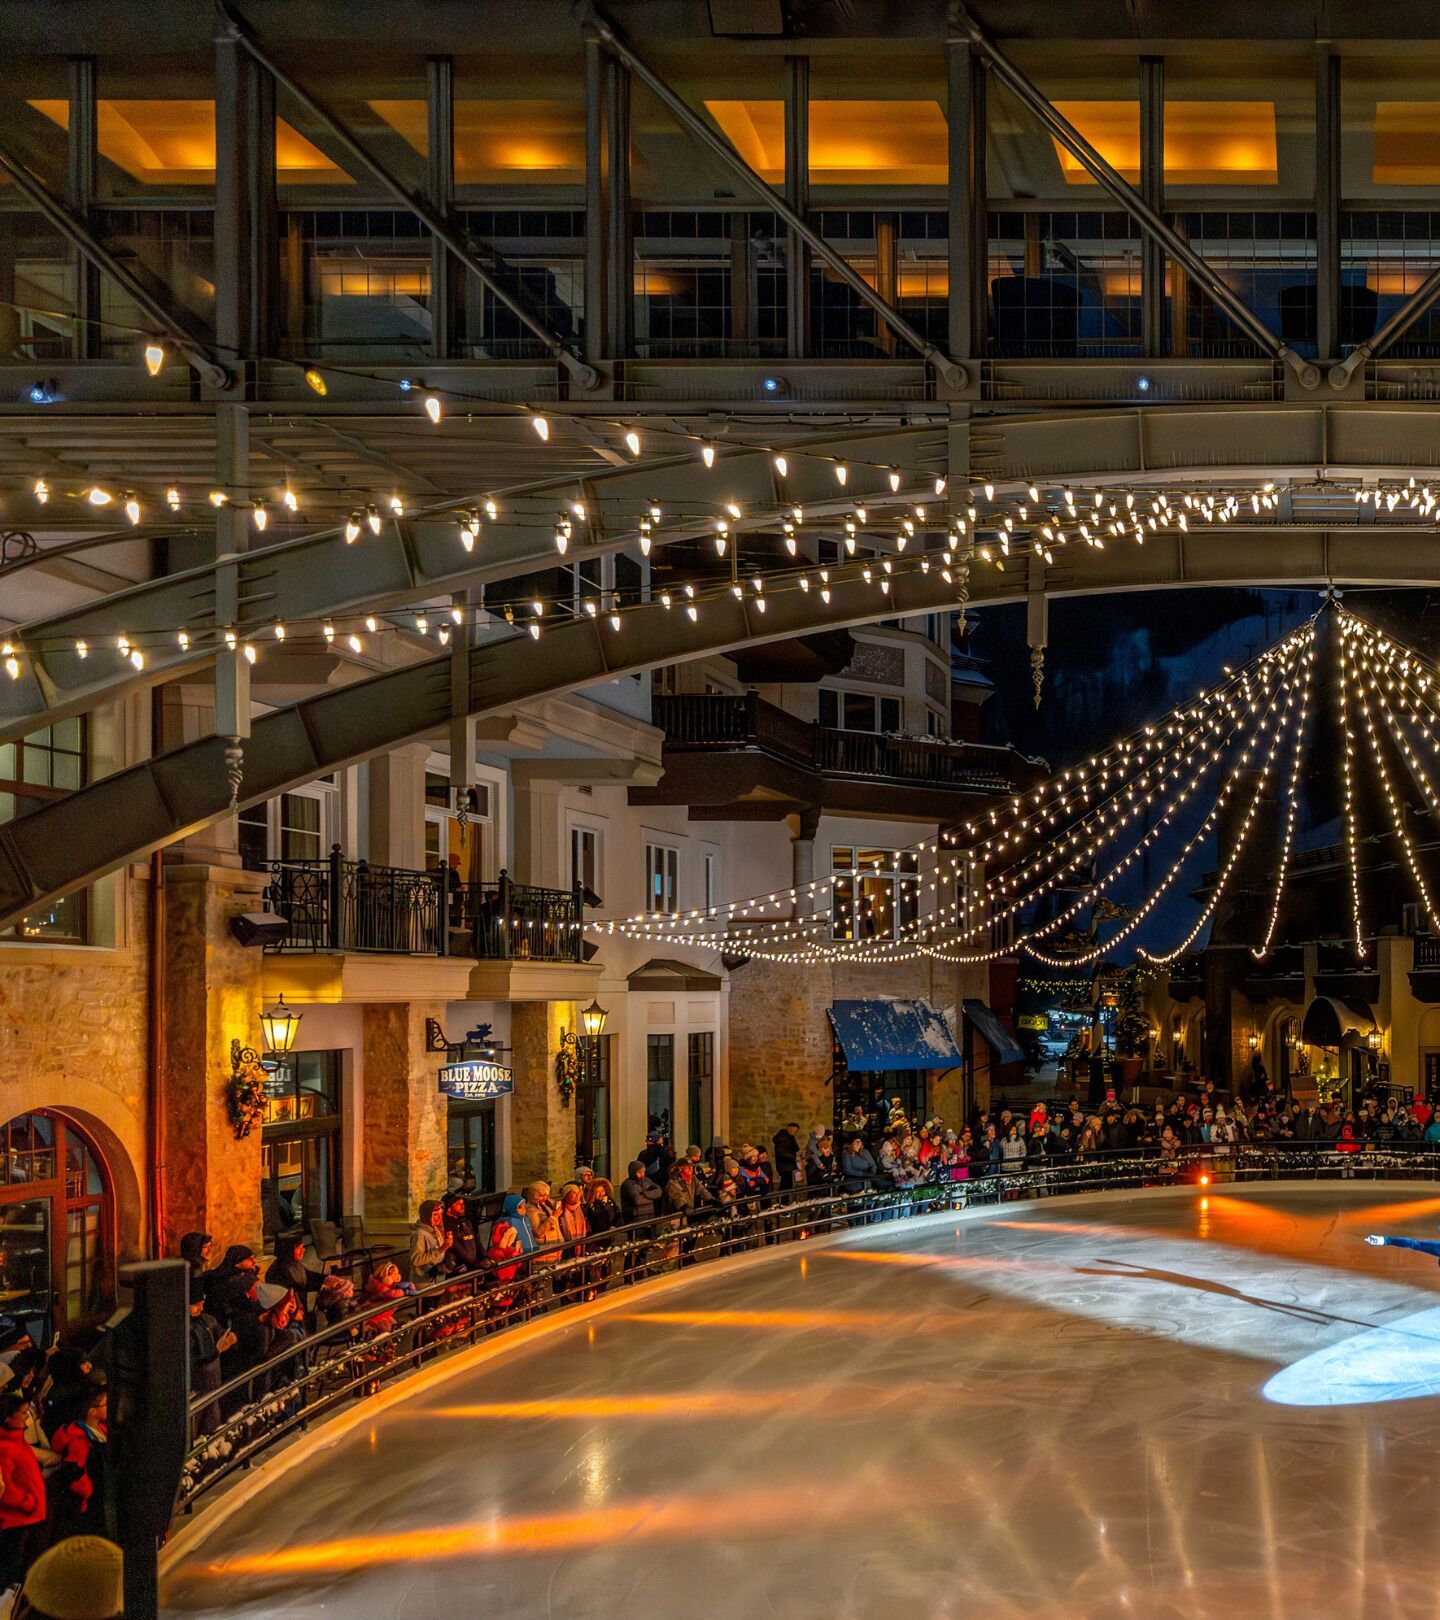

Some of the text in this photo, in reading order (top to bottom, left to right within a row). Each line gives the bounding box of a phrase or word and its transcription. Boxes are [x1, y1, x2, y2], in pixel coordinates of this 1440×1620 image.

[440, 1066, 511, 1081] BLUE MOOSE
[455, 1082, 498, 1093] PIZZA
